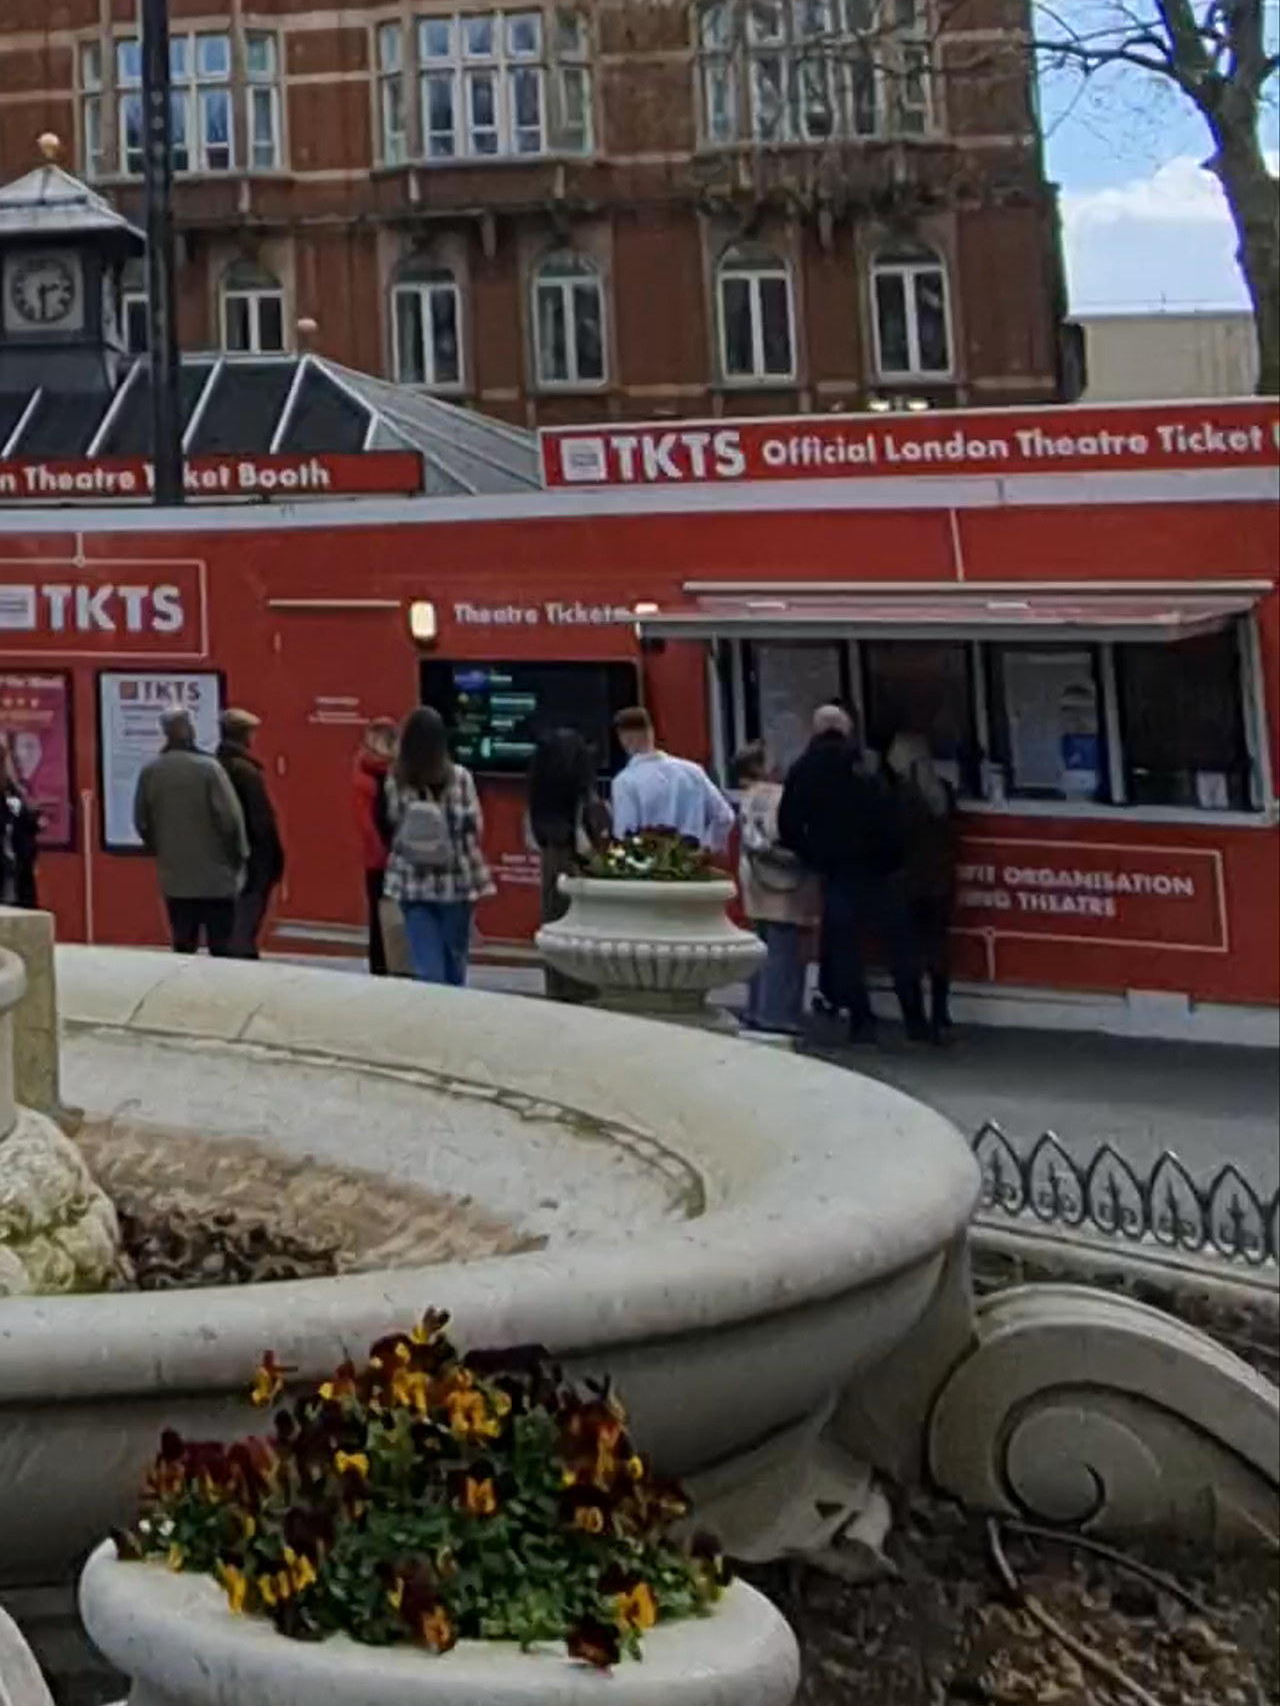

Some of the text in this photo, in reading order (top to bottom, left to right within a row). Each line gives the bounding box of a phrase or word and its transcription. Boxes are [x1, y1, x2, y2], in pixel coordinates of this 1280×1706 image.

[610, 430, 746, 482] TKTS
[762, 432, 877, 466] Official
[885, 430, 1009, 462] London
[1016, 426, 1149, 458] Theatre
[1156, 422, 1263, 453] Ticket
[23, 464, 135, 491] Theatre
[142, 461, 230, 490] Tket
[237, 458, 330, 488] Booth
[42, 584, 184, 632] TKTS
[454, 602, 538, 624] Theatre
[144, 681, 201, 701] TKTS
[1002, 866, 1195, 896] ORGANISATION
[1017, 891, 1117, 917] THEATRE
